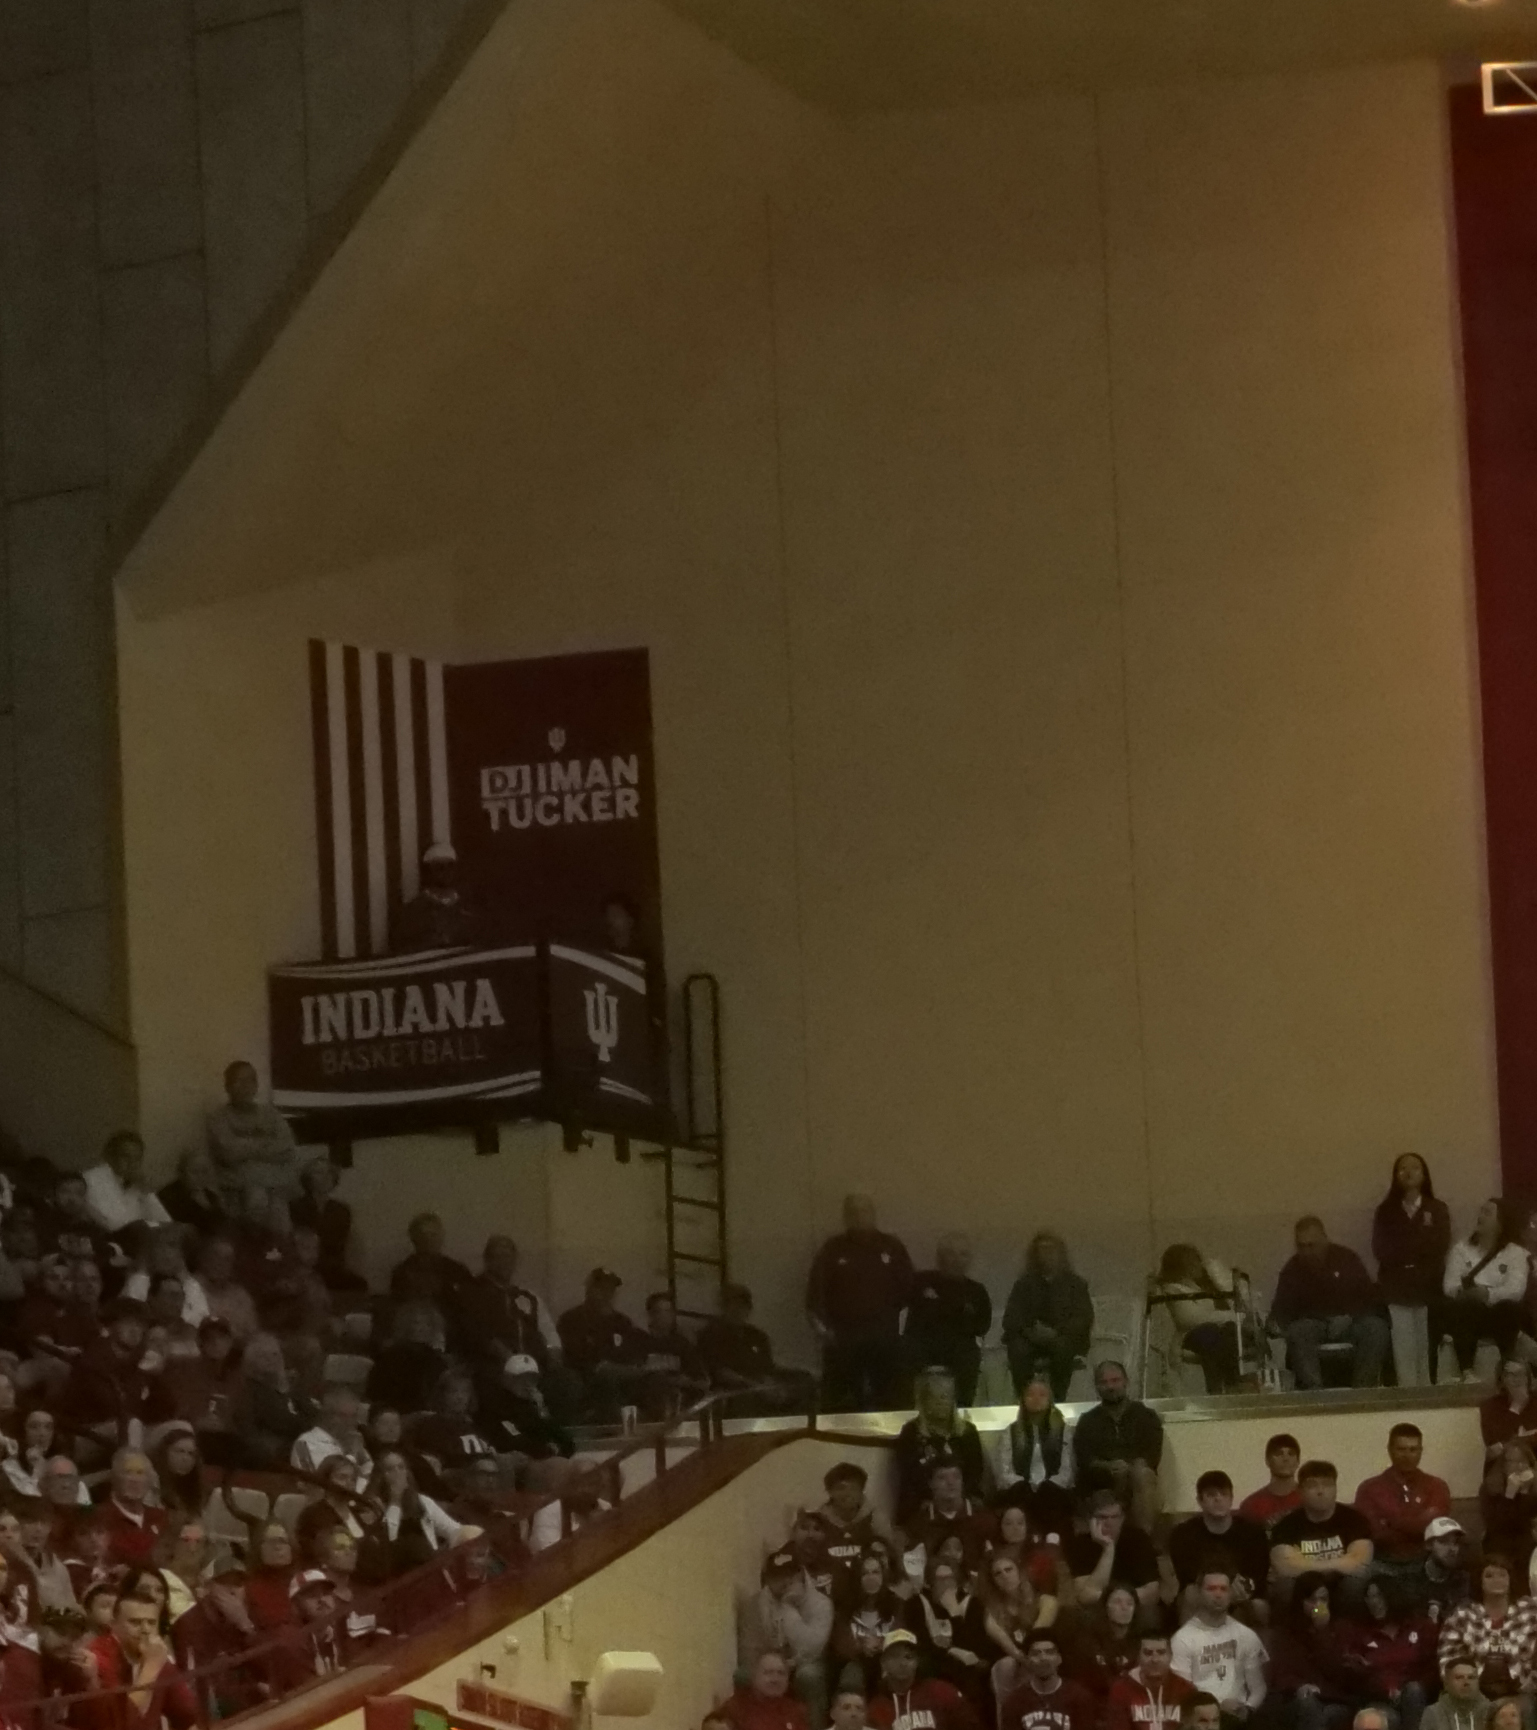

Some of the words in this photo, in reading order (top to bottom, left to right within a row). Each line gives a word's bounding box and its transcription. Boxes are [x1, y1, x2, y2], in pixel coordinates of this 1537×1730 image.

[538, 755, 639, 793] IMAN
[482, 793, 639, 831] TUCKER
[302, 978, 505, 1044] INDIANA
[320, 1039, 486, 1074] BASKETBALL
